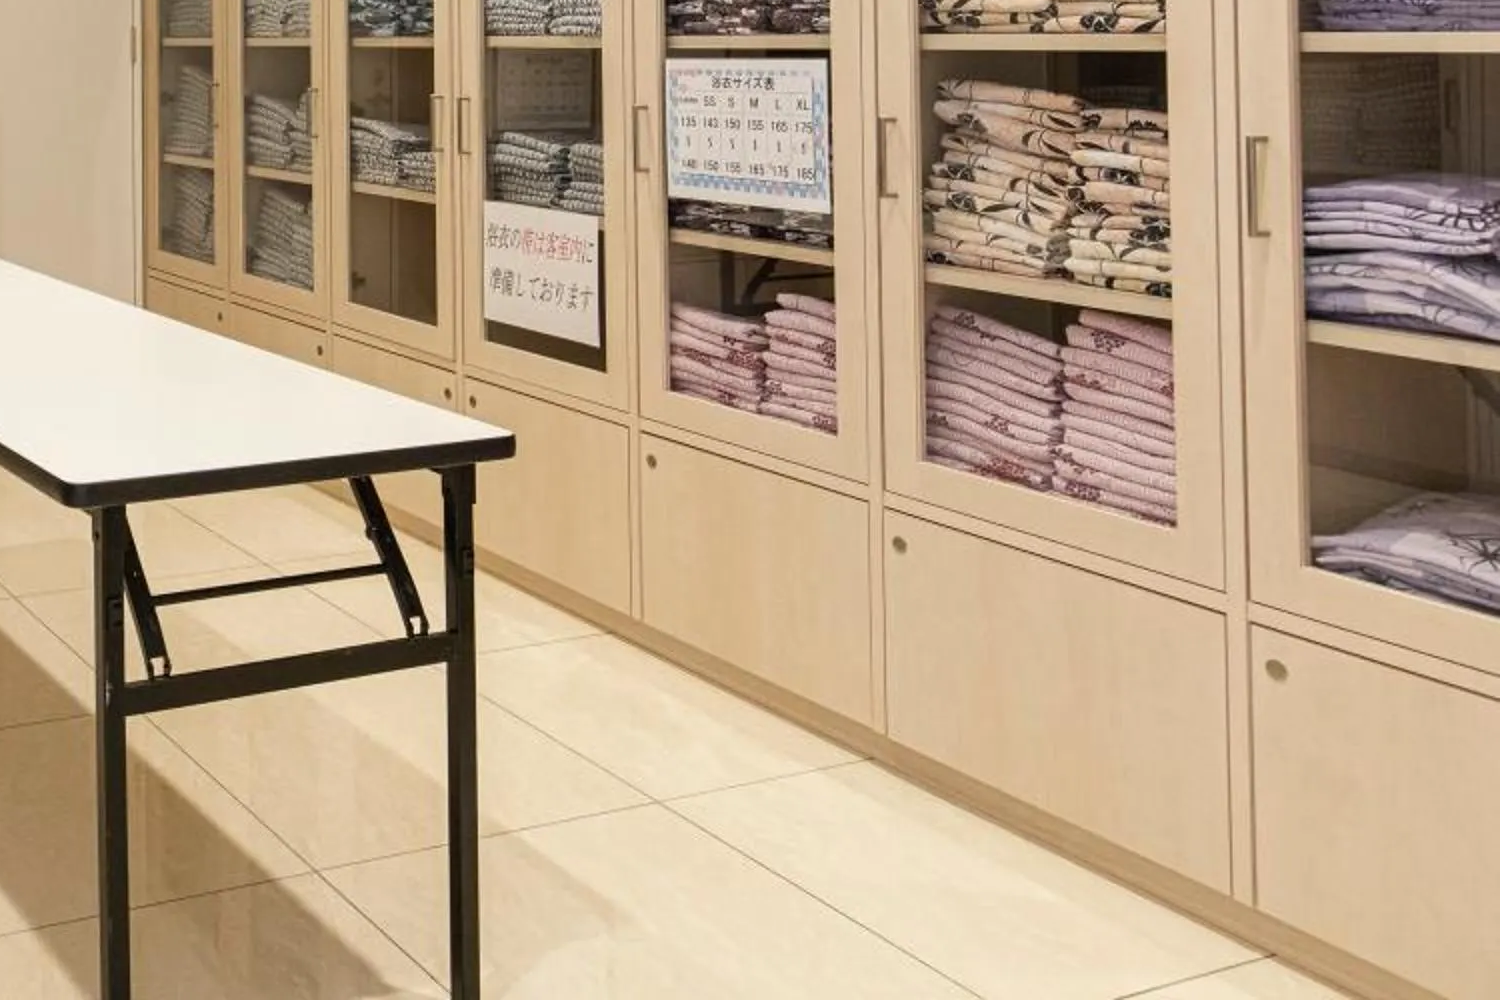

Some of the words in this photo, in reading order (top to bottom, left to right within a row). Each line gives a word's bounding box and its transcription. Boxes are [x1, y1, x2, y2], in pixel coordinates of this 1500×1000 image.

[711, 76, 775, 91] 浴衣サイズ表
[749, 97, 759, 109] M
[796, 98, 812, 111] XL
